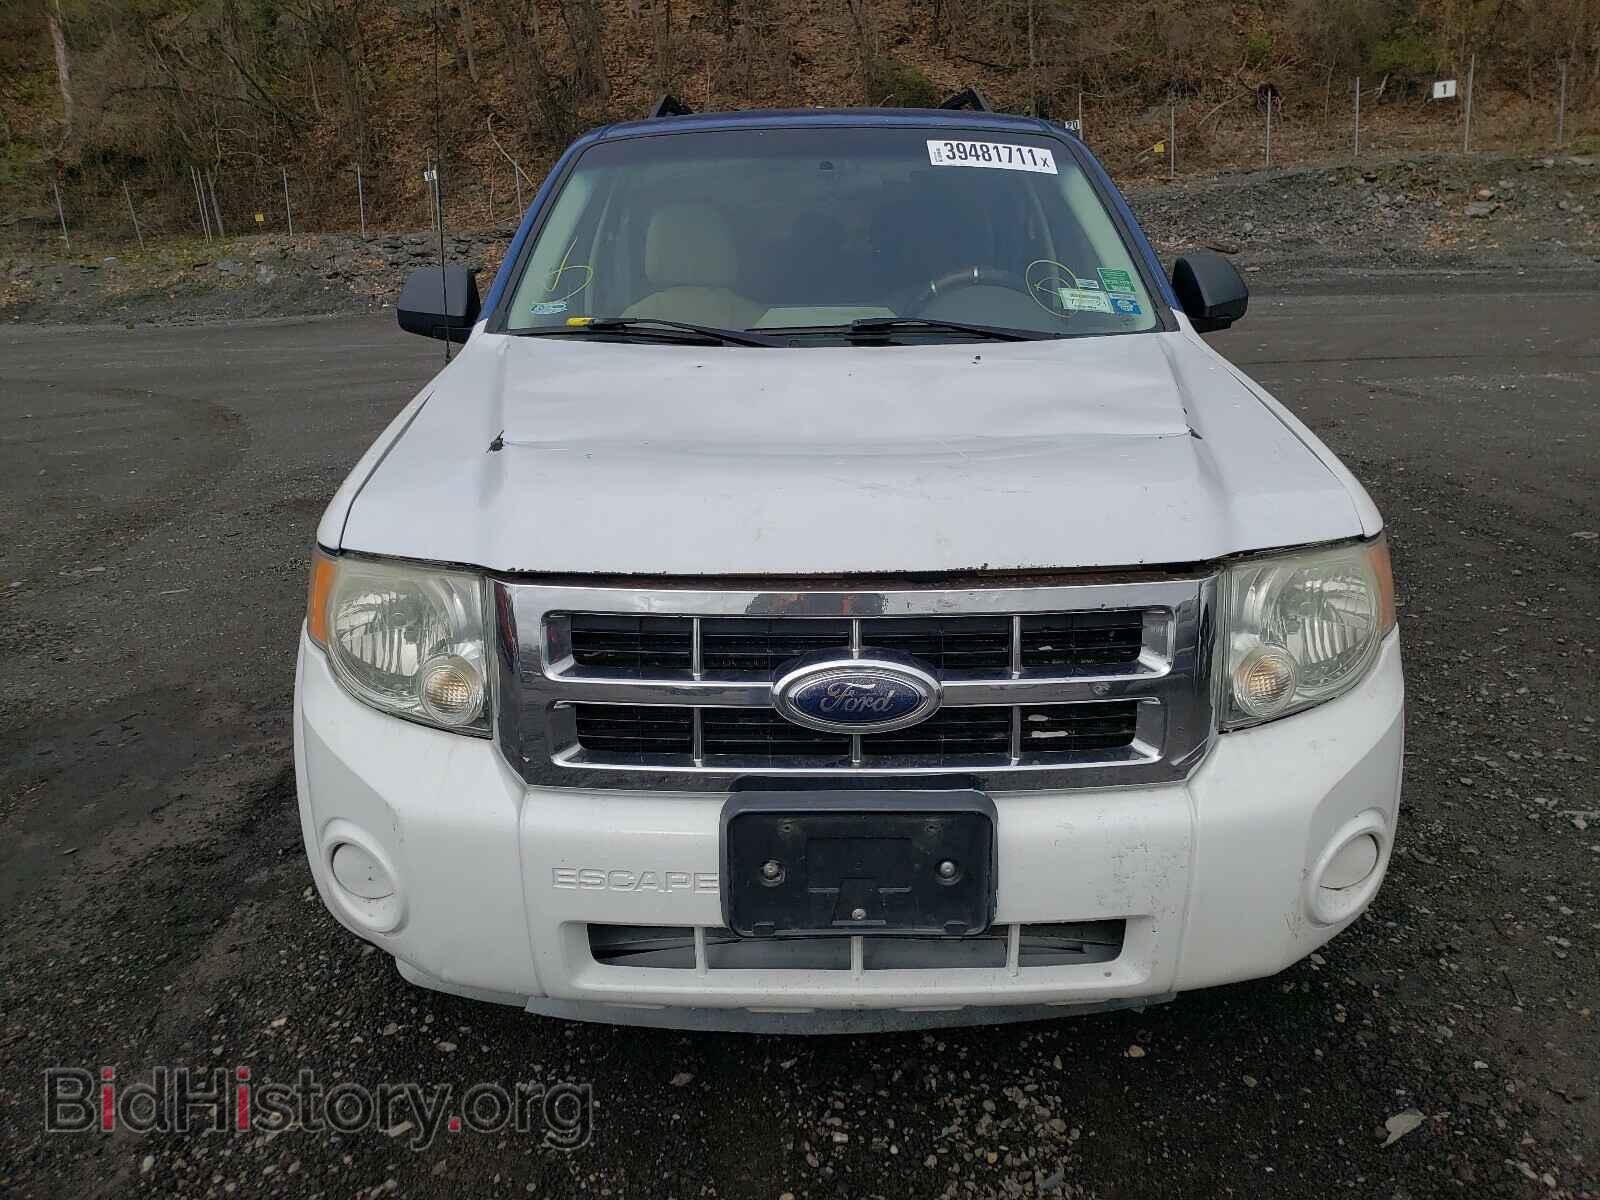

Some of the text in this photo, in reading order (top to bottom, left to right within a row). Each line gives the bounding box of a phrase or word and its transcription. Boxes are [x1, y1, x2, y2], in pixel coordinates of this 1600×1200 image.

[943, 142, 1038, 167] 39481711
[818, 681, 895, 712] Ford
[551, 867, 720, 894] ESCAPE
